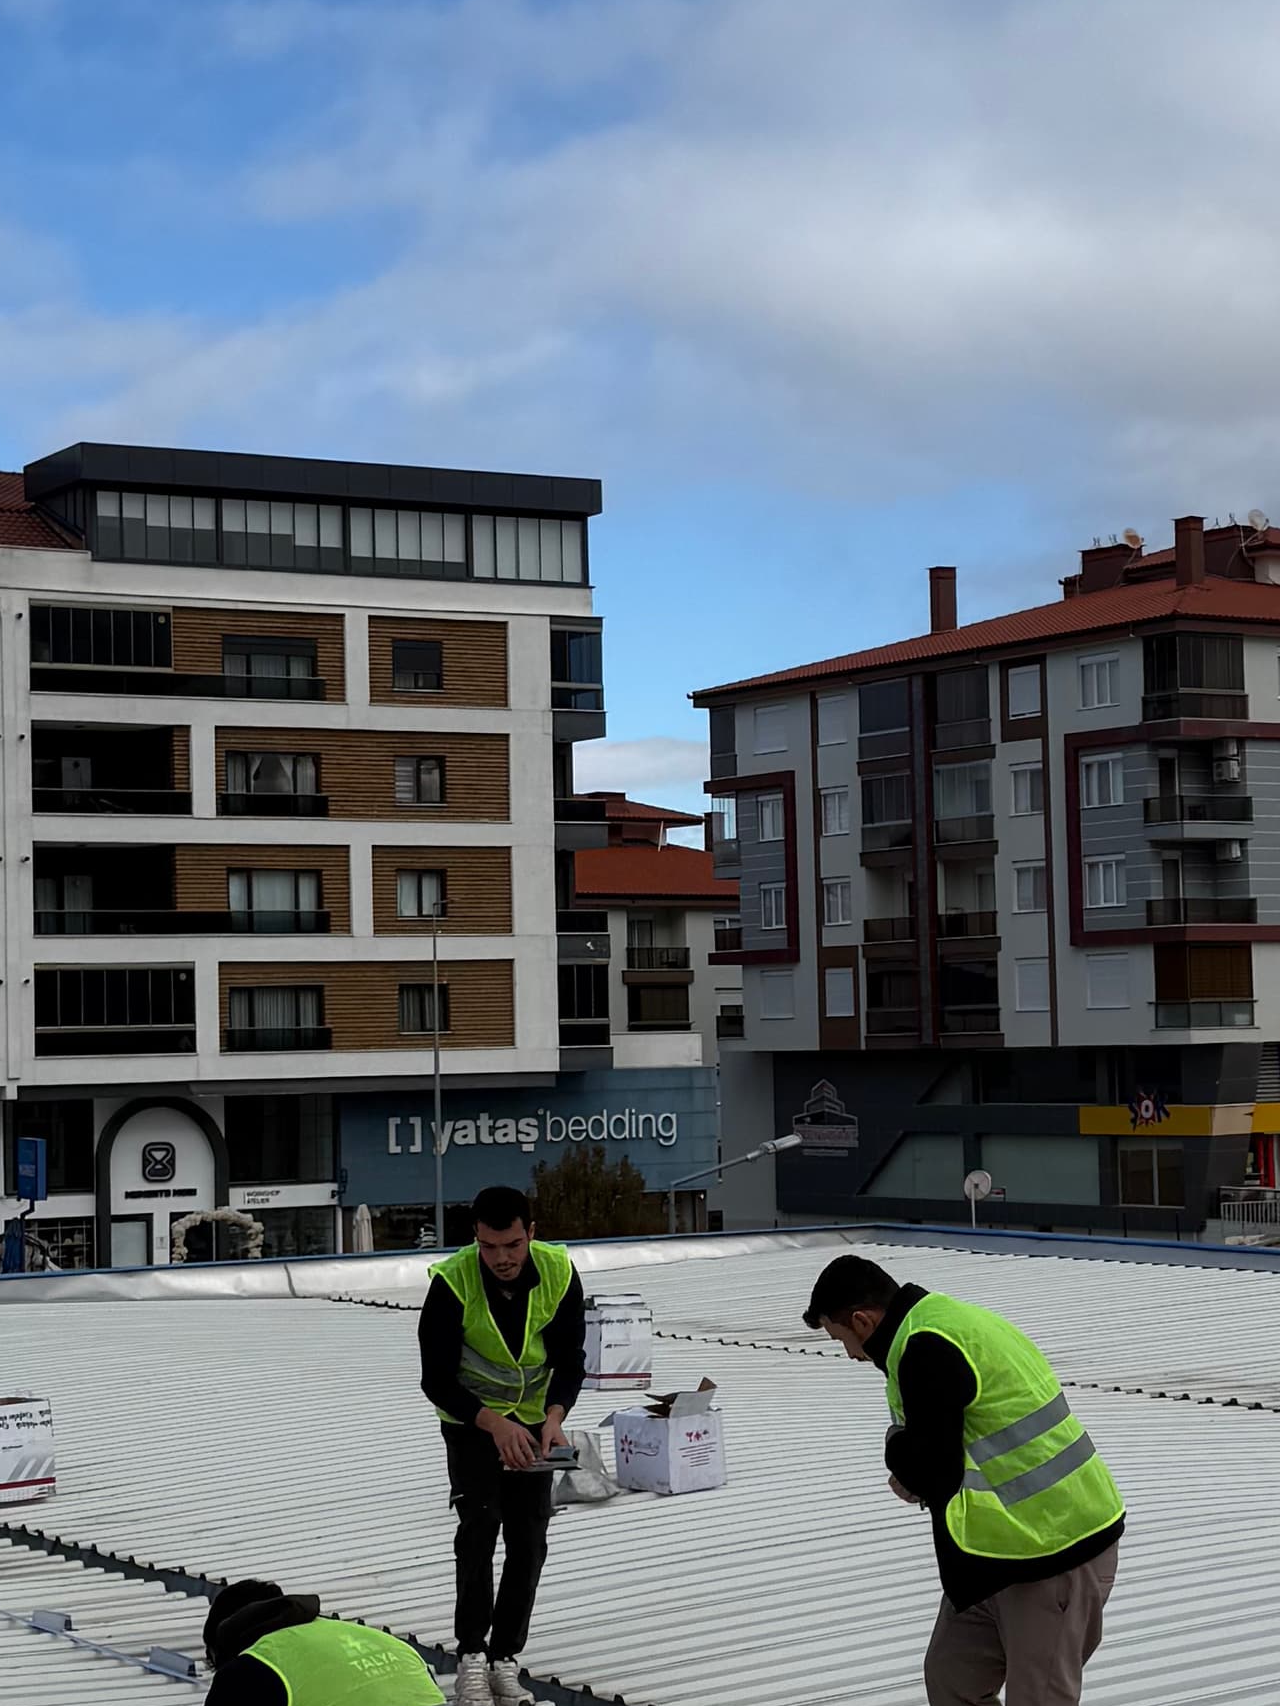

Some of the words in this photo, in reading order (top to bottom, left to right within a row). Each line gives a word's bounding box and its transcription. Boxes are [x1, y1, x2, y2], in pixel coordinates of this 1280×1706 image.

[431, 1112, 539, 1157] yataş
[546, 1108, 678, 1147] bedding
[349, 1652, 400, 1671] TALYA
